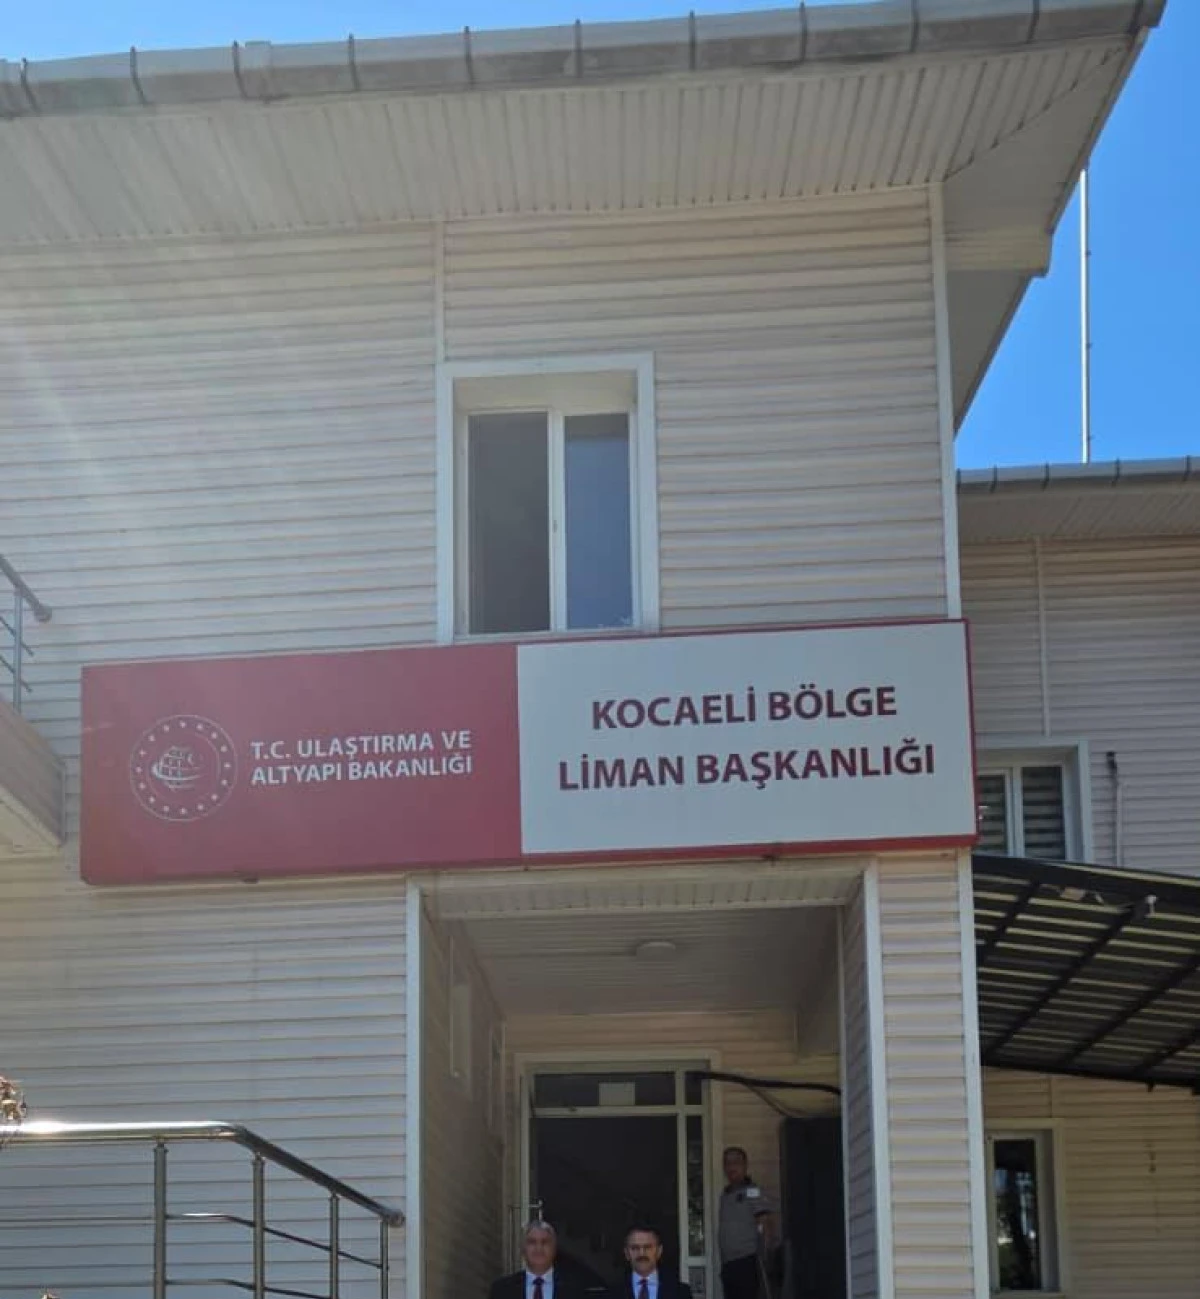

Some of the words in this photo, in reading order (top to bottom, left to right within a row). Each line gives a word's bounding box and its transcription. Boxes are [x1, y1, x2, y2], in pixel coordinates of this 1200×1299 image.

[592, 686, 756, 730] KOCAELİ
[768, 683, 897, 722] BÖLGE
[251, 741, 291, 761] T.C.
[297, 731, 434, 761] ULAŞTIRMA
[441, 730, 472, 749] VE
[559, 753, 685, 791] LİMAN
[697, 738, 935, 789] BAŞKANLIĞI
[251, 763, 342, 786] ALTYAPI
[349, 752, 472, 781] BAKANLIĞI
